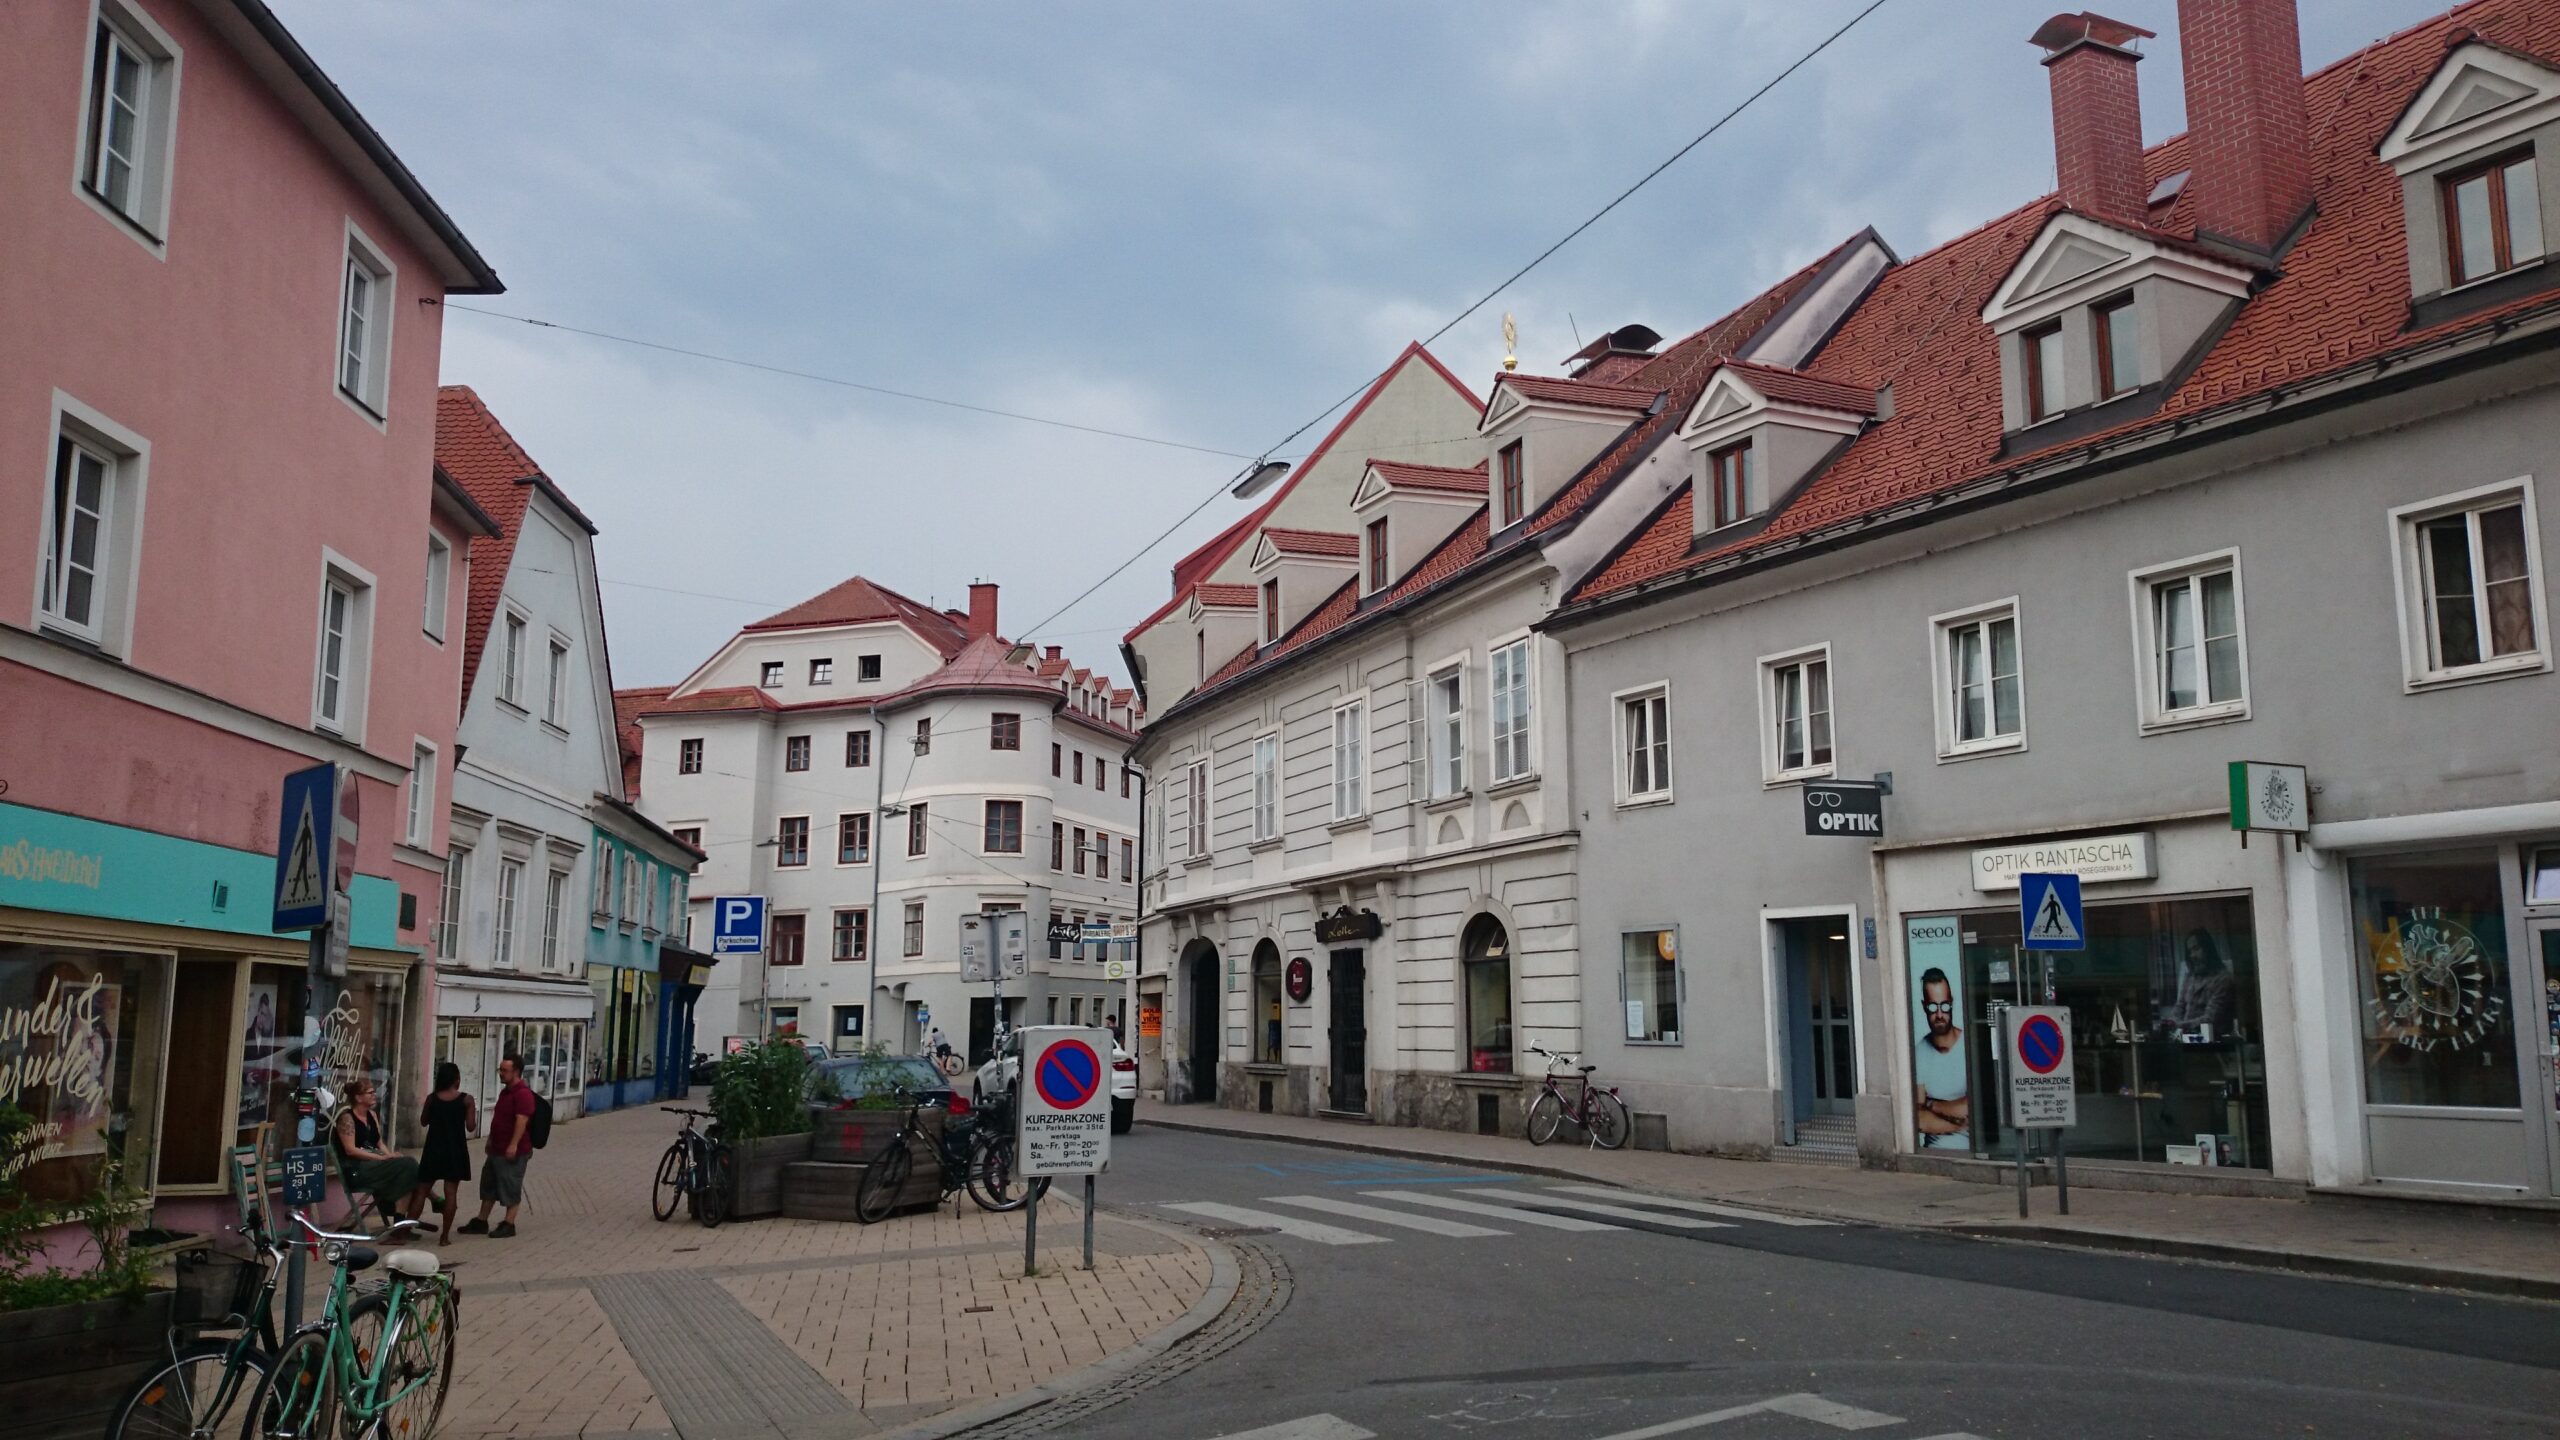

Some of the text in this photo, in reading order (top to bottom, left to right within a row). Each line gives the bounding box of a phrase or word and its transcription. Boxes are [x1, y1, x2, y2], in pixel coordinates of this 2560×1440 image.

[1818, 812, 1880, 832] OPTIK
[1982, 843, 2133, 873] OPTIK RANTASCHA
[725, 900, 752, 934] P
[1911, 926, 1954, 939] seeoo
[2015, 1077, 2071, 1085] KURZPARKZONE
[1025, 1114, 1106, 1124] KURZPARKZONE
[287, 1161, 305, 1174] HS
[1036, 1160, 1093, 1169] gebührenpflichtig
